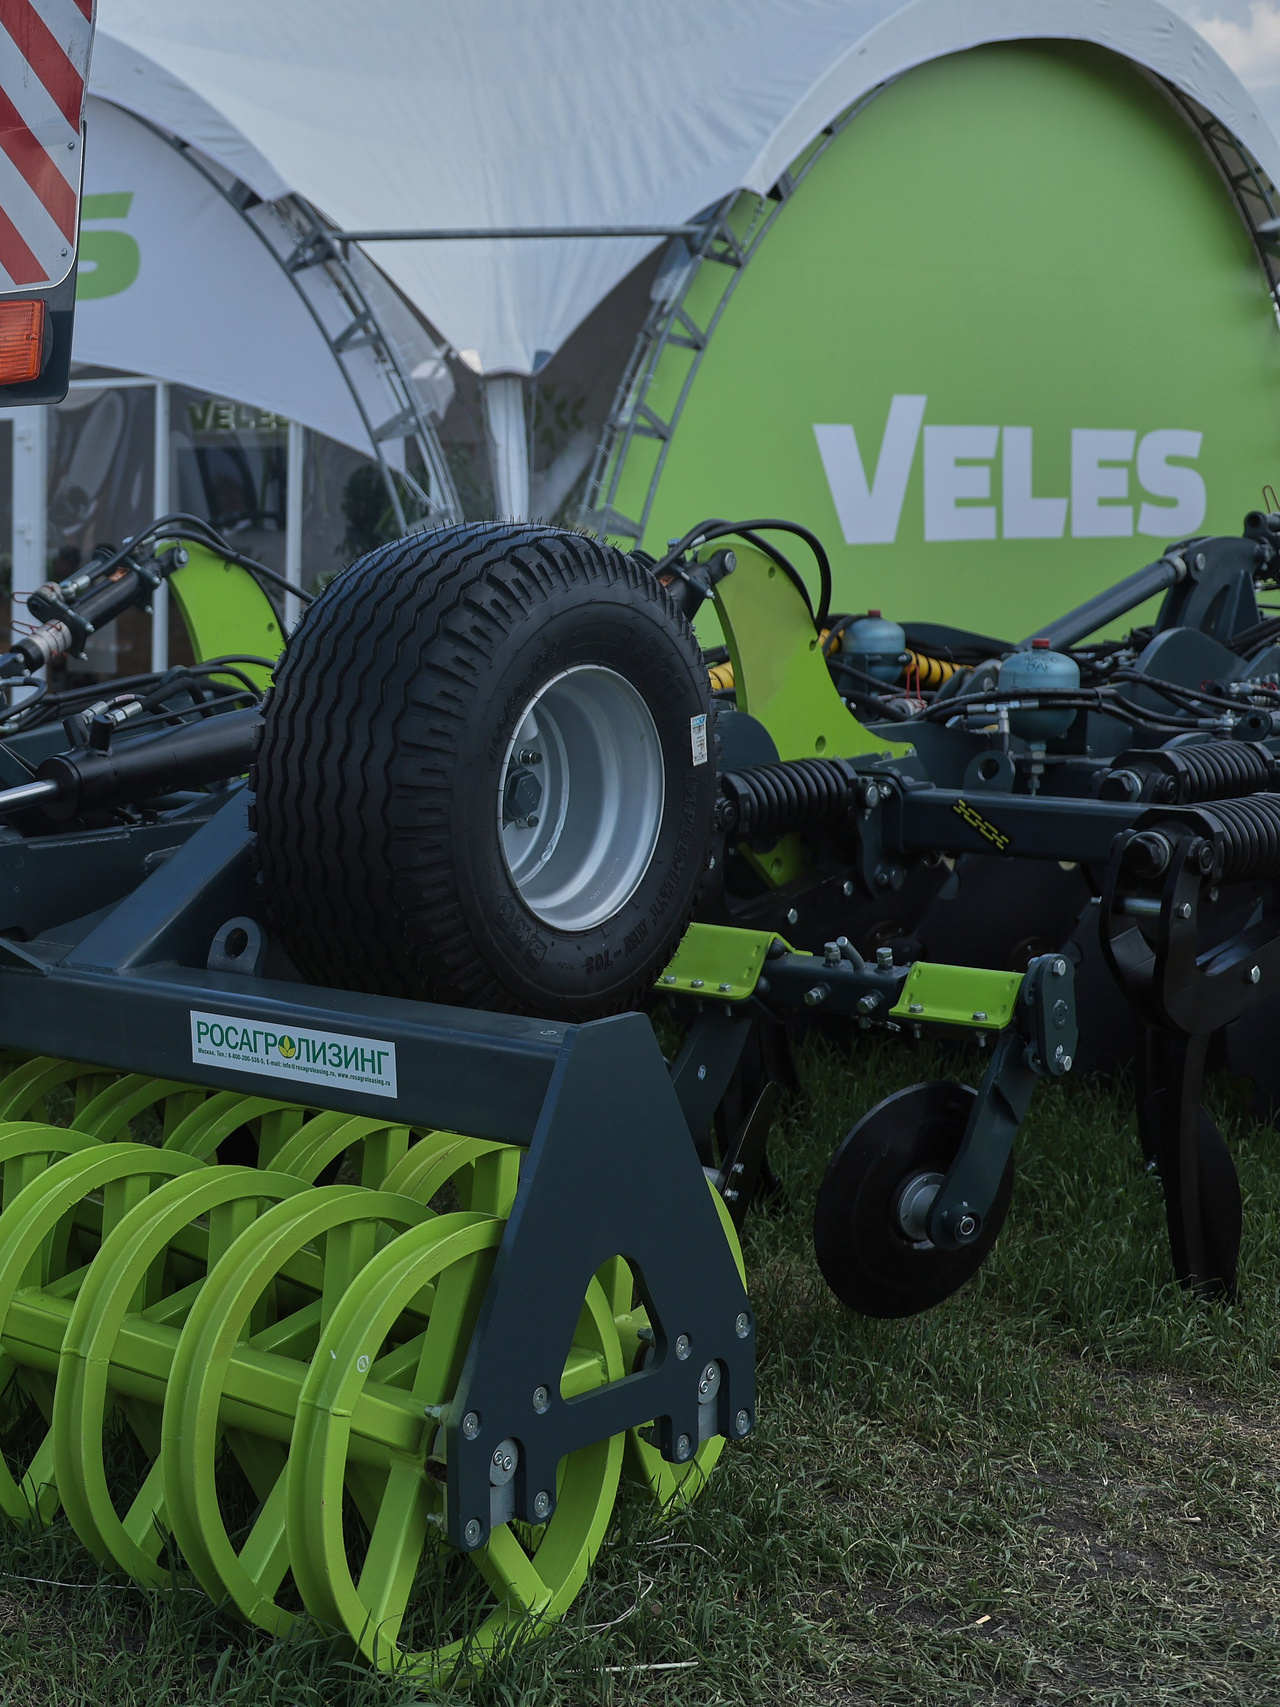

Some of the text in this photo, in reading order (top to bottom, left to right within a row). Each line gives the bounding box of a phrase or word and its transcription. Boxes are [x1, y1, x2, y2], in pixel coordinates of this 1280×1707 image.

[187, 399, 289, 431] VELE
[812, 394, 1207, 545] VELES
[196, 1020, 390, 1075] РОСАГРОЛИЗИНГ
